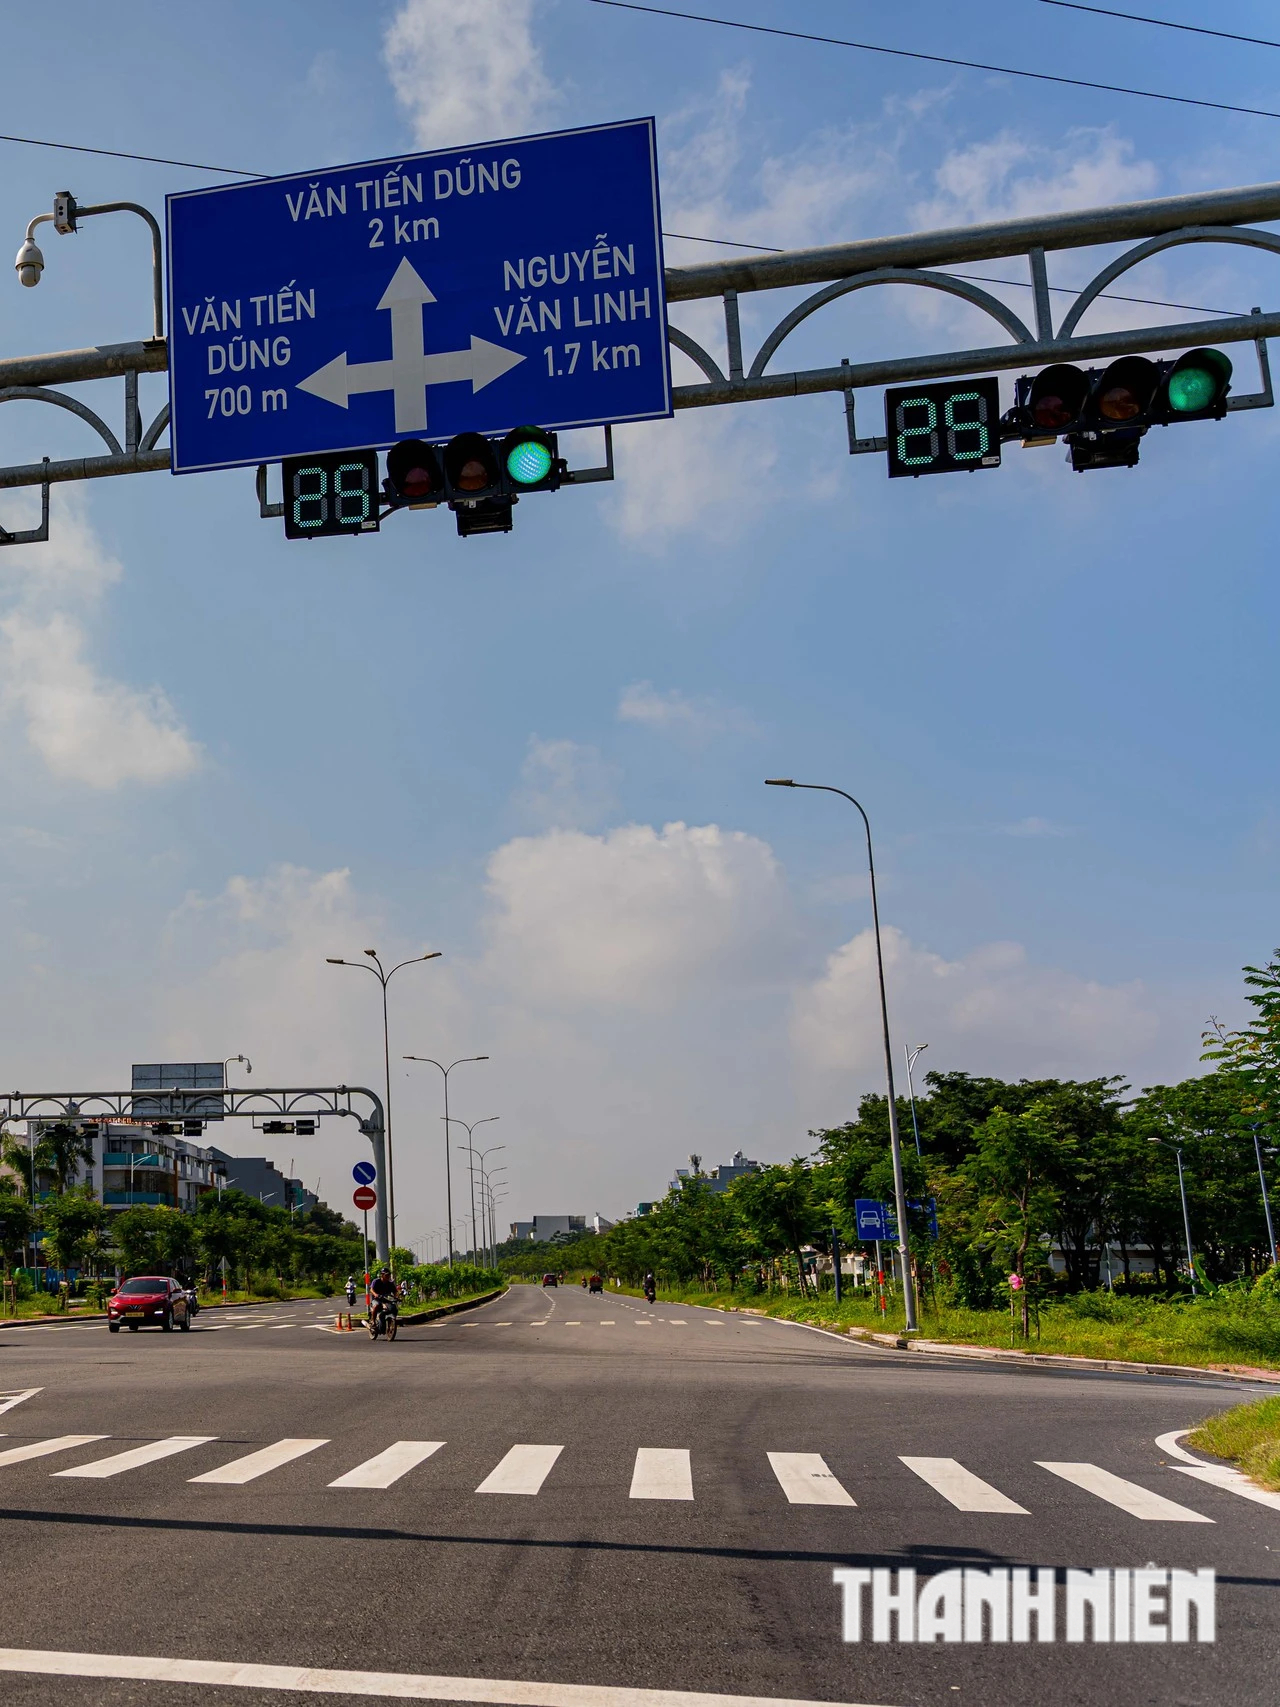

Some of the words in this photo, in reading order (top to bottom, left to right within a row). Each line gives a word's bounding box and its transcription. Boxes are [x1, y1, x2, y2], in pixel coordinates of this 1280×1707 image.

[285, 182, 347, 222] VĂN
[355, 164, 423, 211] TIẾN
[433, 157, 522, 200] DŨNG
[368, 217, 385, 249] 2
[394, 214, 440, 245] km
[503, 232, 636, 291] NGUYỄN
[181, 295, 241, 336] VĂN
[249, 279, 316, 326] TIẾN
[493, 295, 562, 337] VĂN
[573, 287, 651, 328] LINH
[207, 334, 291, 375] DŨNG
[543, 342, 581, 377] 1.7
[591, 340, 641, 372] km
[204, 384, 252, 419] 700
[261, 388, 288, 413] m
